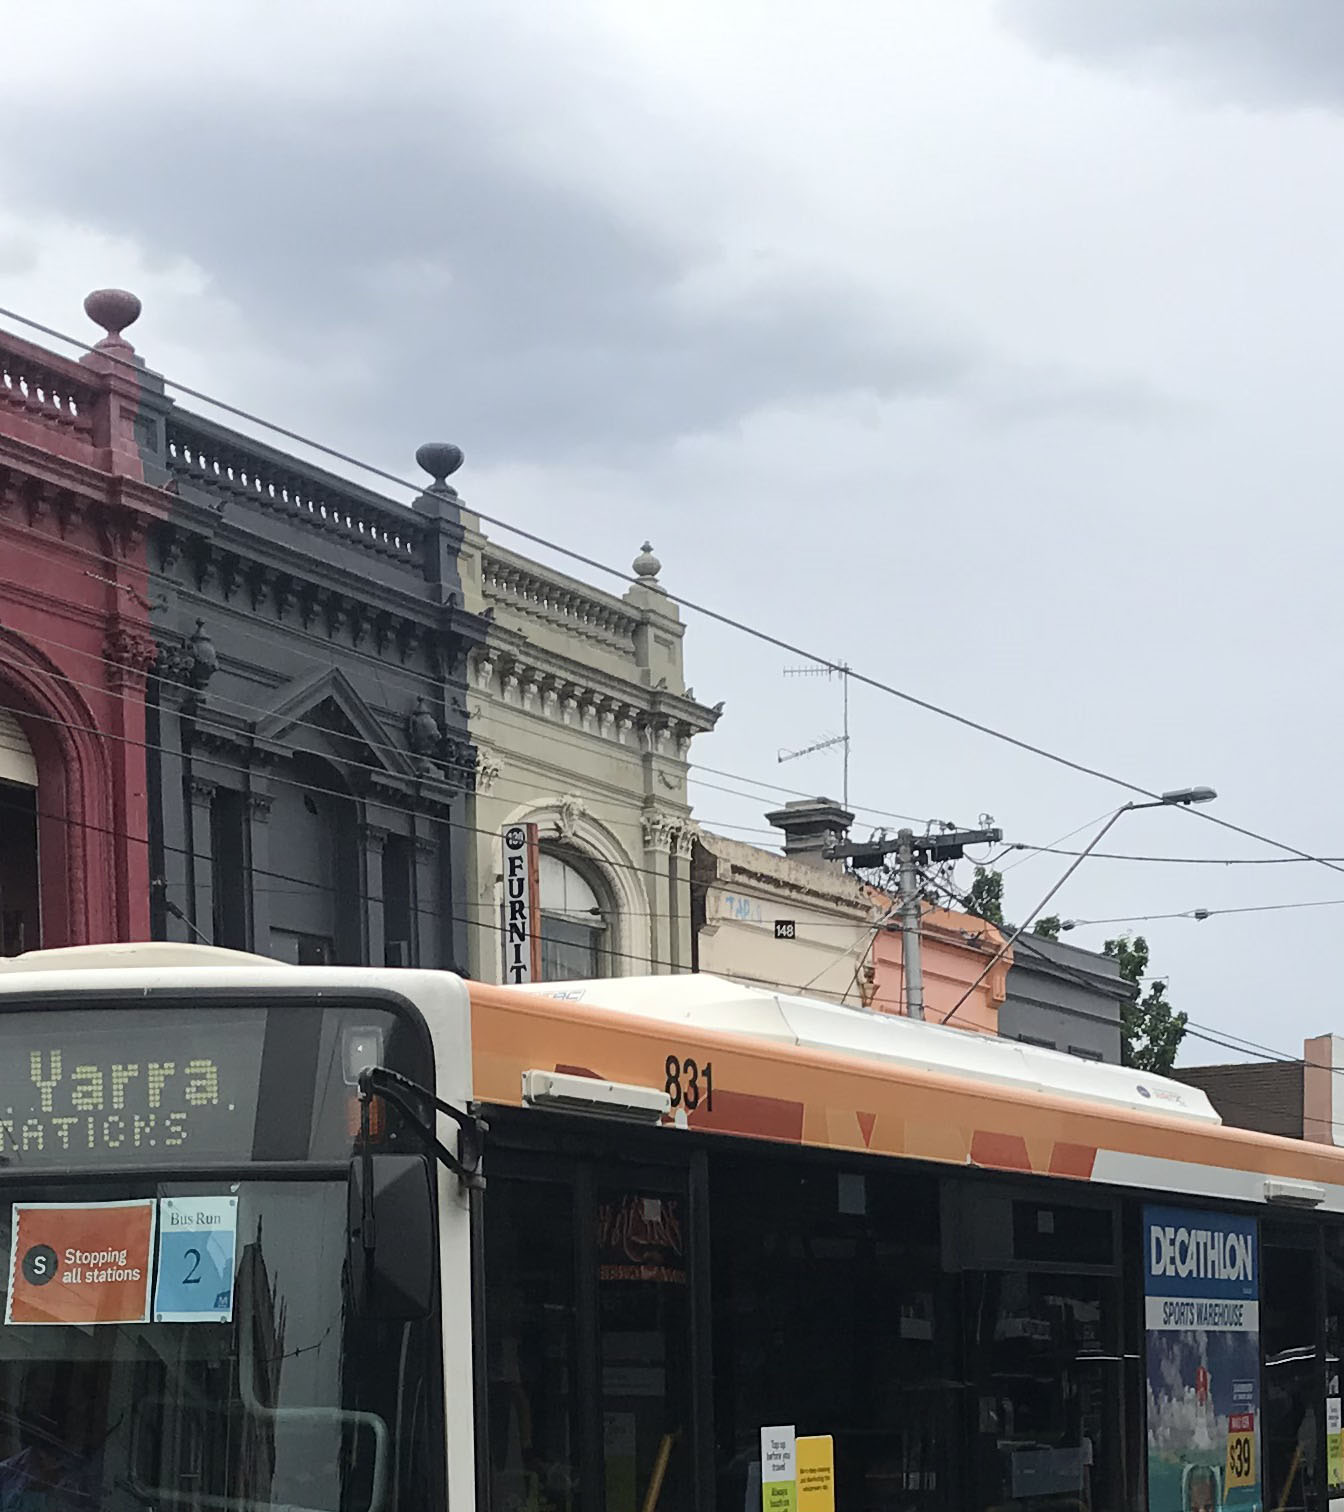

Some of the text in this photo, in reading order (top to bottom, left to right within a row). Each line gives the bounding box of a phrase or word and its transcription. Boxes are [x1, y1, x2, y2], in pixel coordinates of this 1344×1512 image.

[776, 924, 794, 937] 148
[30, 1050, 219, 1112] Yarra
[665, 1055, 712, 1112] 831
[170, 1212, 221, 1225] Bus Run
[33, 1256, 46, 1275] S
[65, 1247, 127, 1266] Stopping
[1150, 1225, 1253, 1280] DECATHLON
[62, 1267, 141, 1283] all stations
[182, 1248, 201, 1284] 2
[1163, 1301, 1244, 1327] SPORTS WAREHOUSE
[1230, 1437, 1250, 1478] $39
